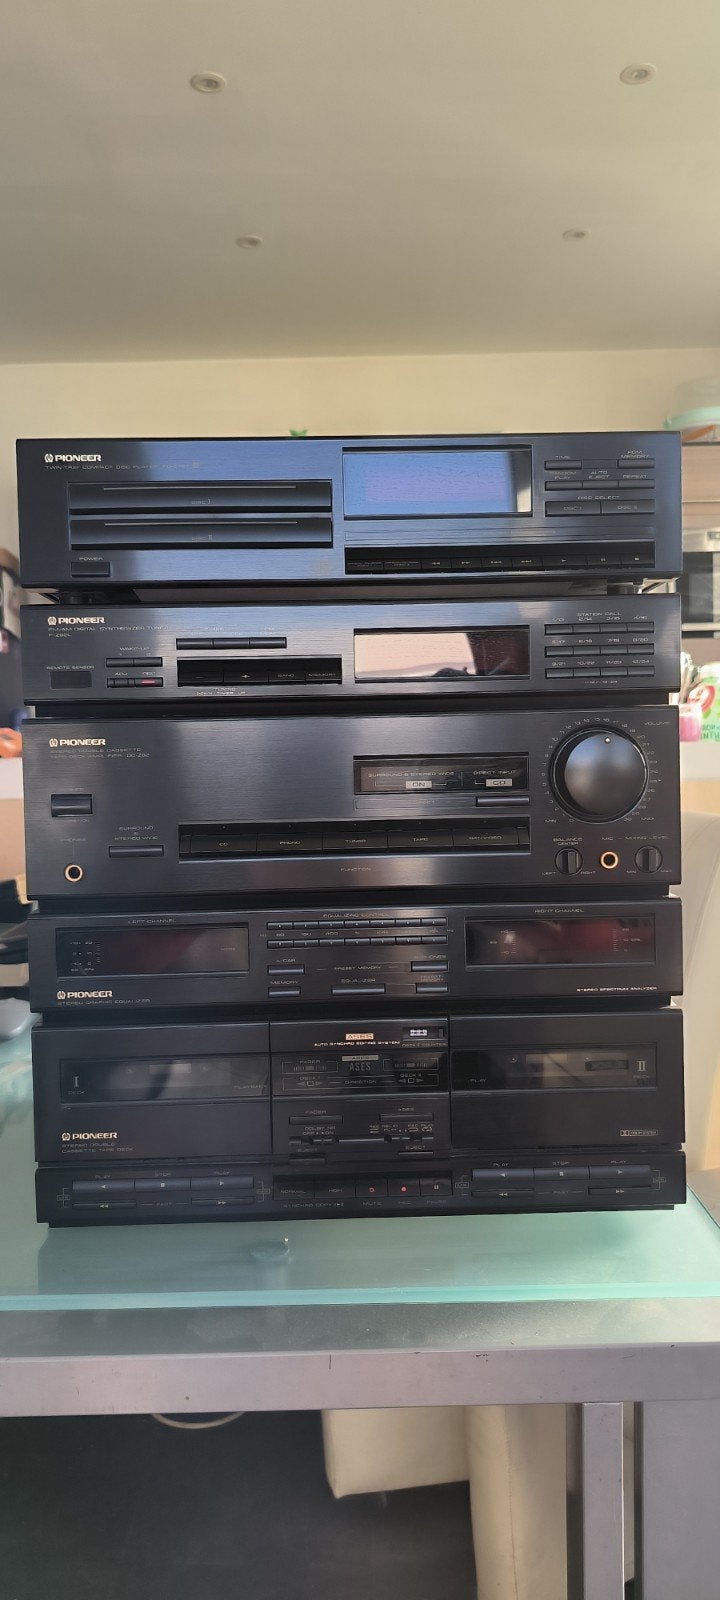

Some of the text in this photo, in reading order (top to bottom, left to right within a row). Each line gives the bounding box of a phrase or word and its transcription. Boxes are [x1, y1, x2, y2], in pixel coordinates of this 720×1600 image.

[55, 454, 102, 462] PIONEER
[58, 616, 105, 625] PIONEER
[59, 738, 106, 746] PIONEER
[67, 990, 113, 999] PIONEER
[349, 1062, 371, 1072] ASES
[637, 1060, 647, 1071] II
[74, 1076, 79, 1088] I
[72, 1132, 118, 1140] PIONEER
